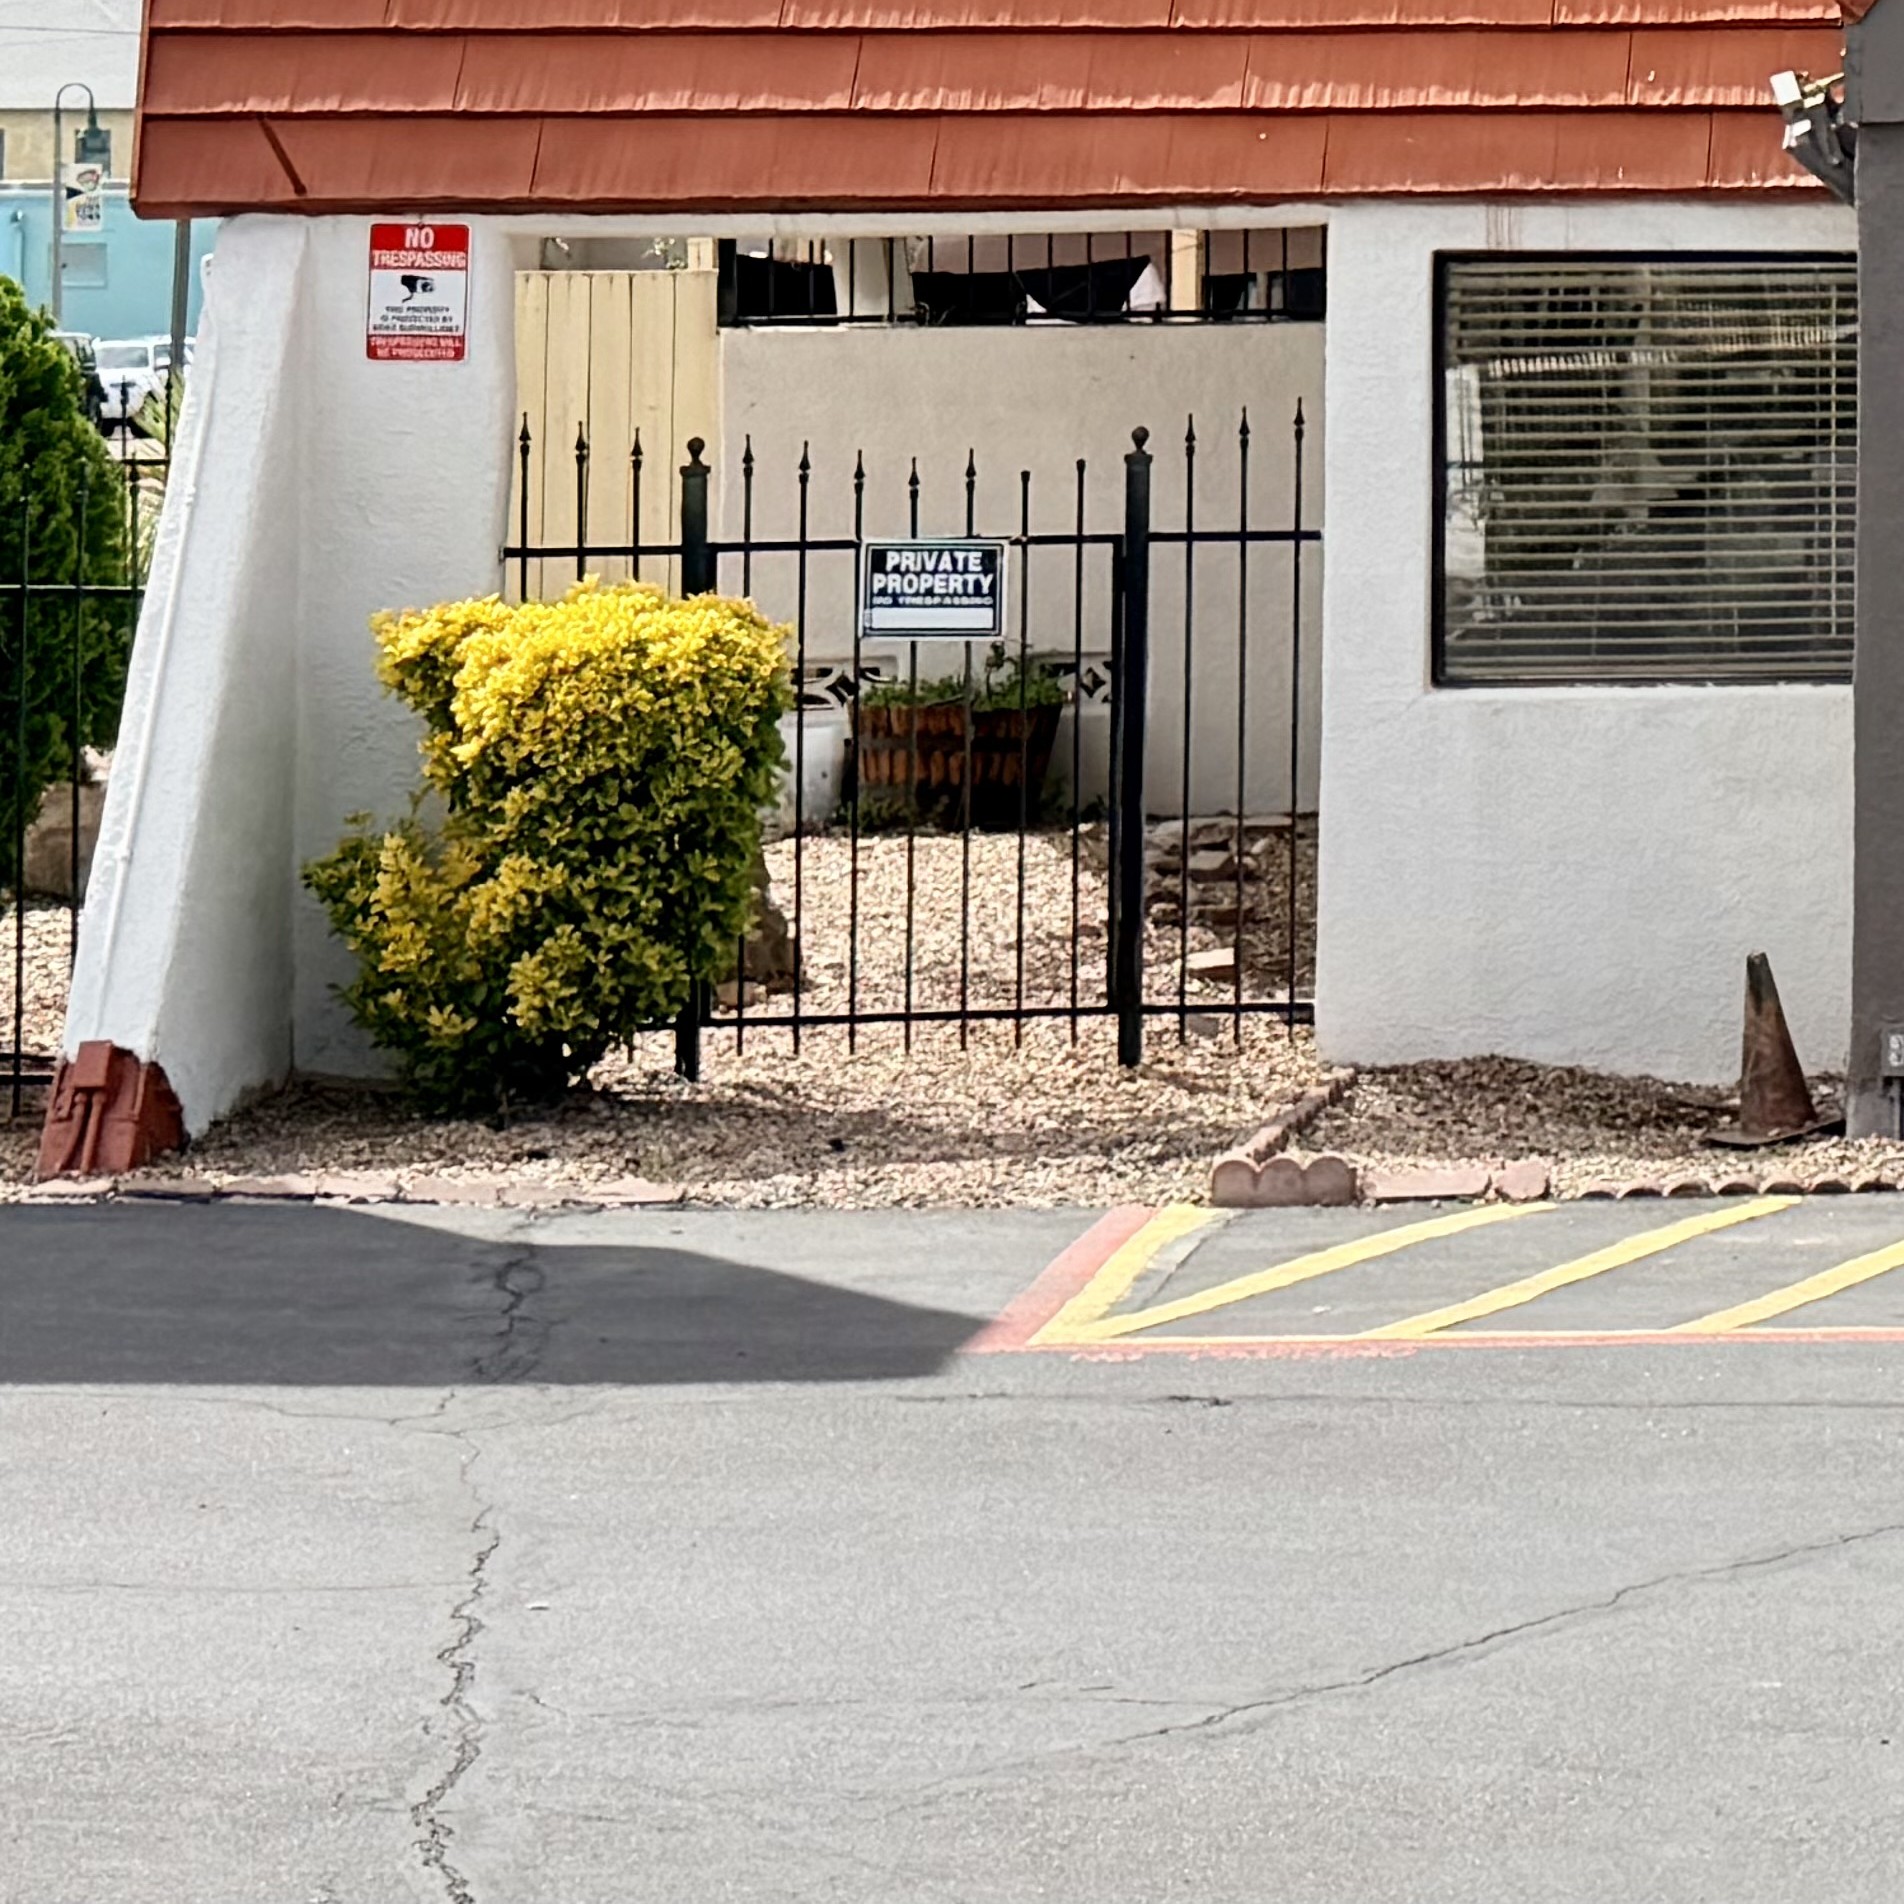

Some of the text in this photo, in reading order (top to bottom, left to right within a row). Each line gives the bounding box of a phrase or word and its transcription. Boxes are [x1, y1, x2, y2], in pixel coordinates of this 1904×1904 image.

[405, 227, 434, 248] NO
[372, 250, 466, 267] TRESPASSING
[886, 551, 982, 572] PRIVATE
[872, 573, 993, 594] PROPERTY
